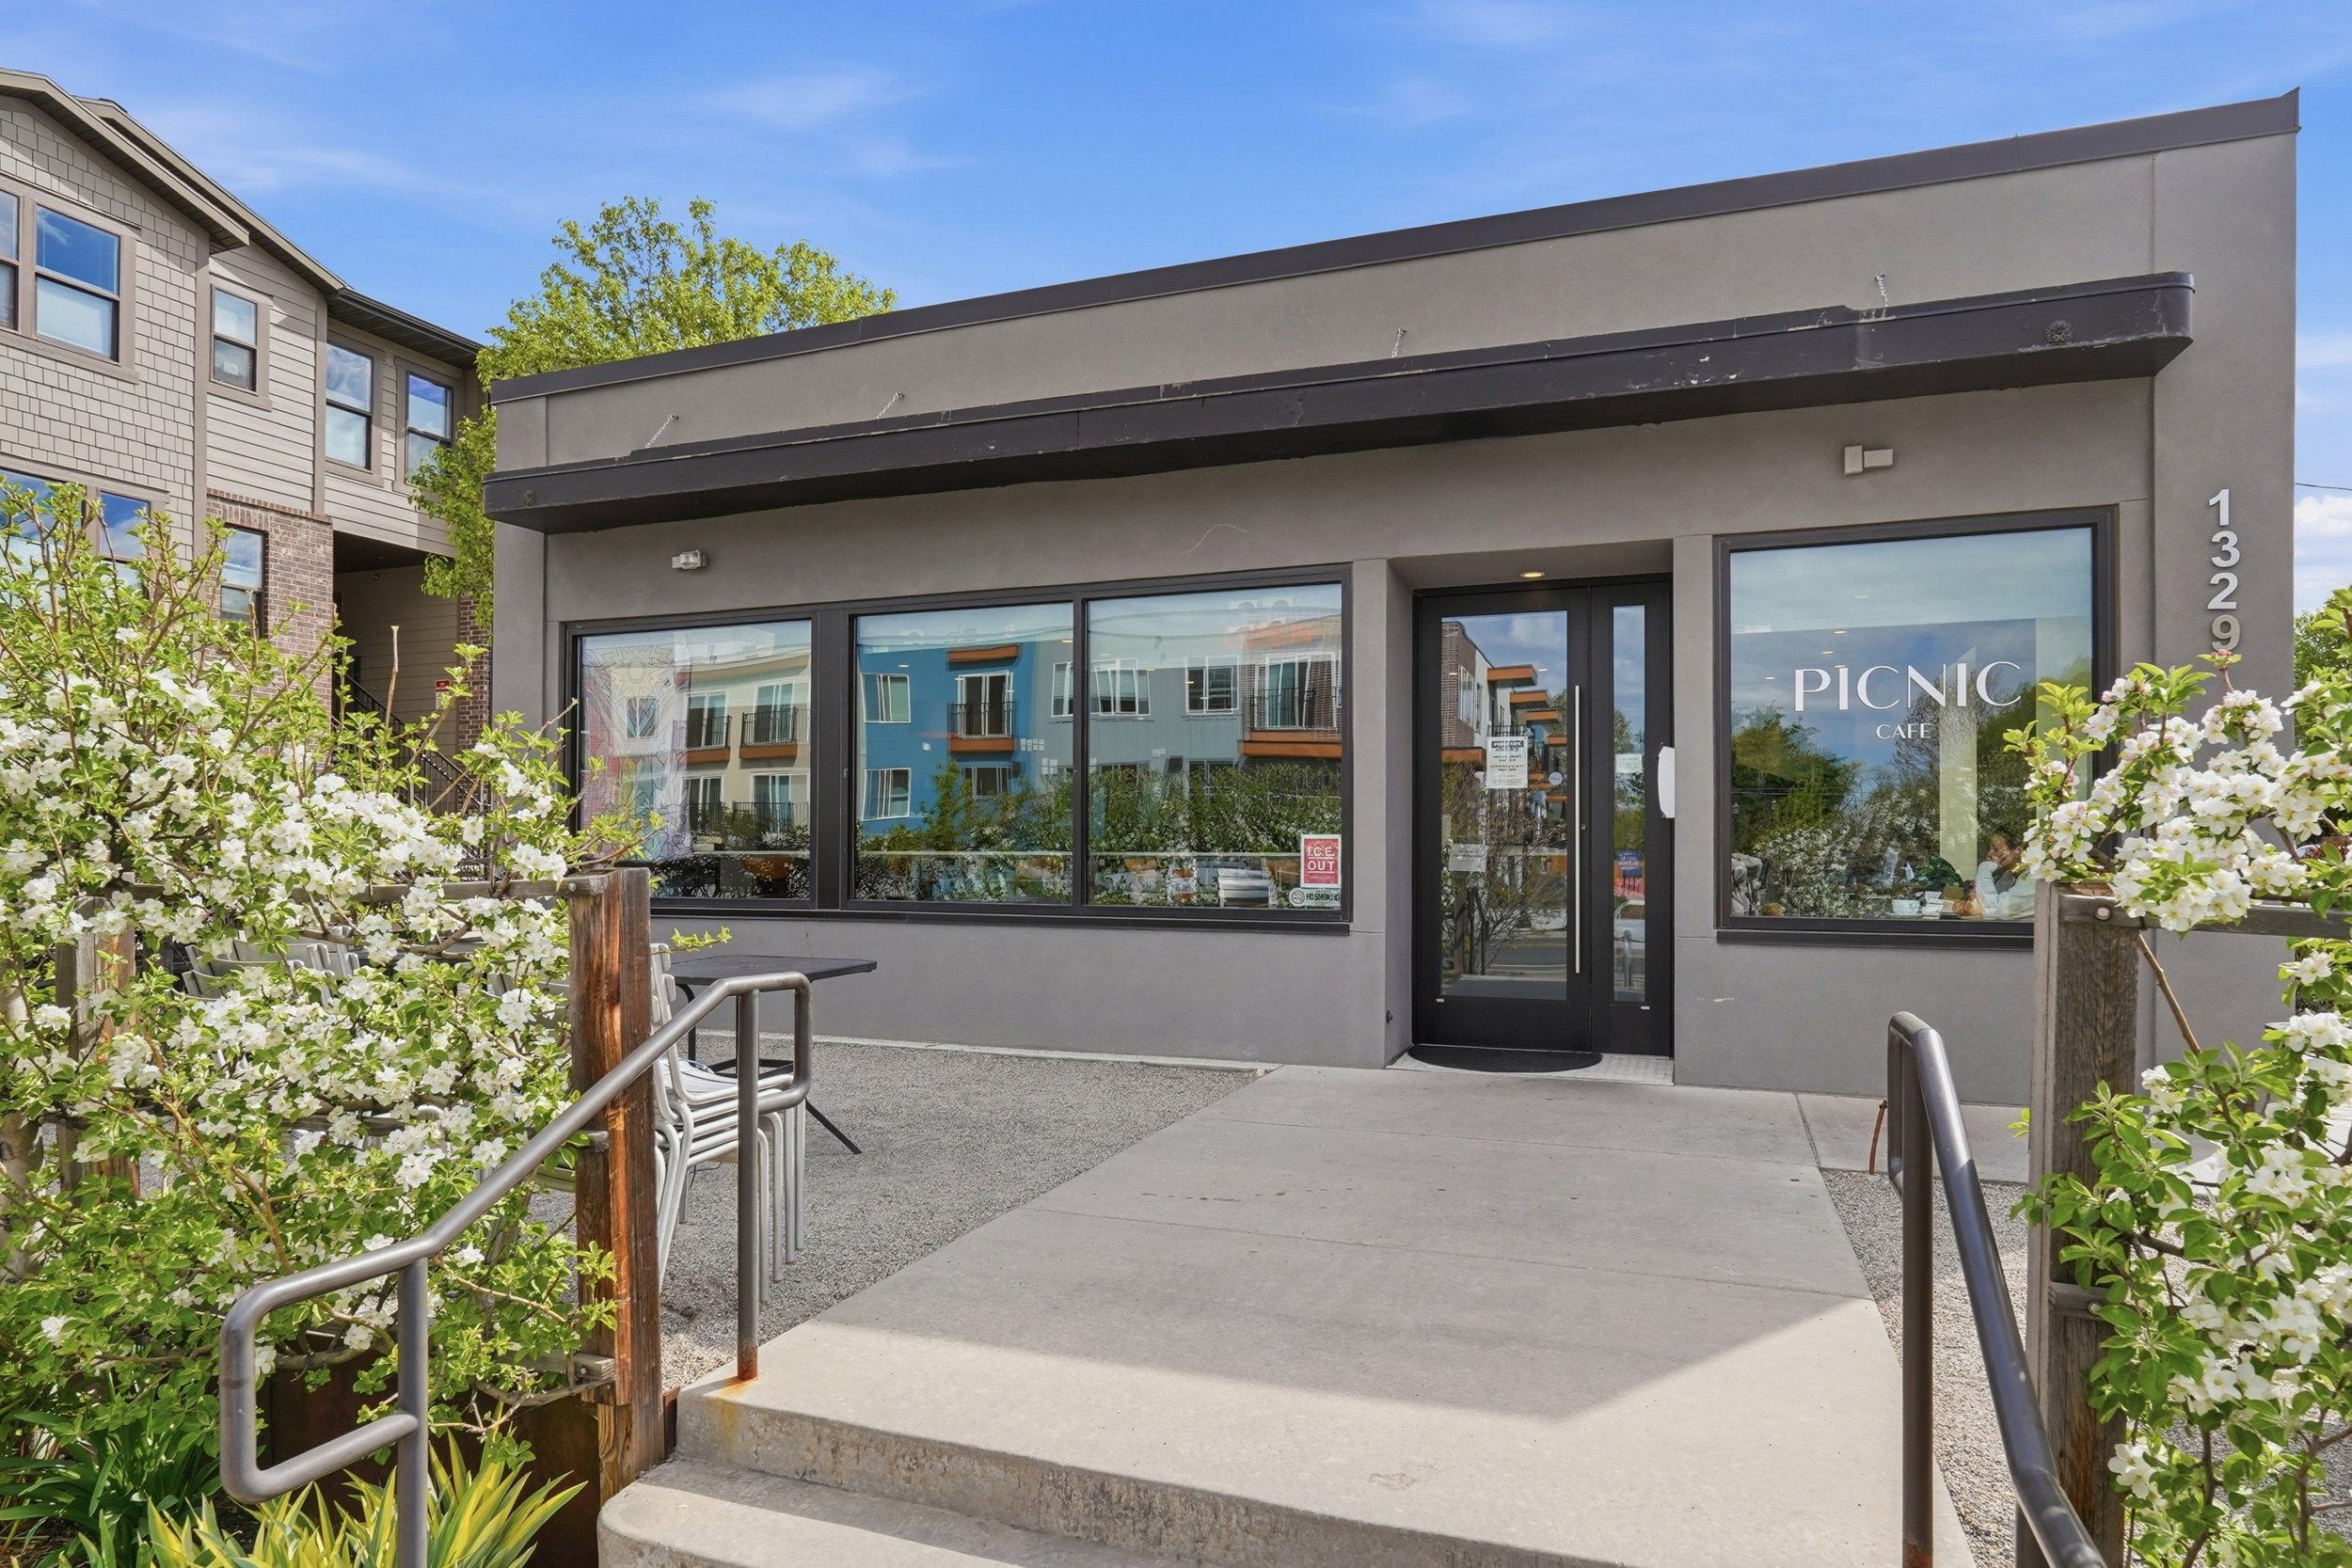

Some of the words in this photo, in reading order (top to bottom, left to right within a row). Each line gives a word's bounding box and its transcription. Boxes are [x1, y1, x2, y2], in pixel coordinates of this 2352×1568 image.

[2207, 489, 2240, 651] 1329
[1795, 661, 2021, 711] PICNIC
[1876, 723, 1931, 739] CAFE
[1308, 861, 1336, 871] OUT
